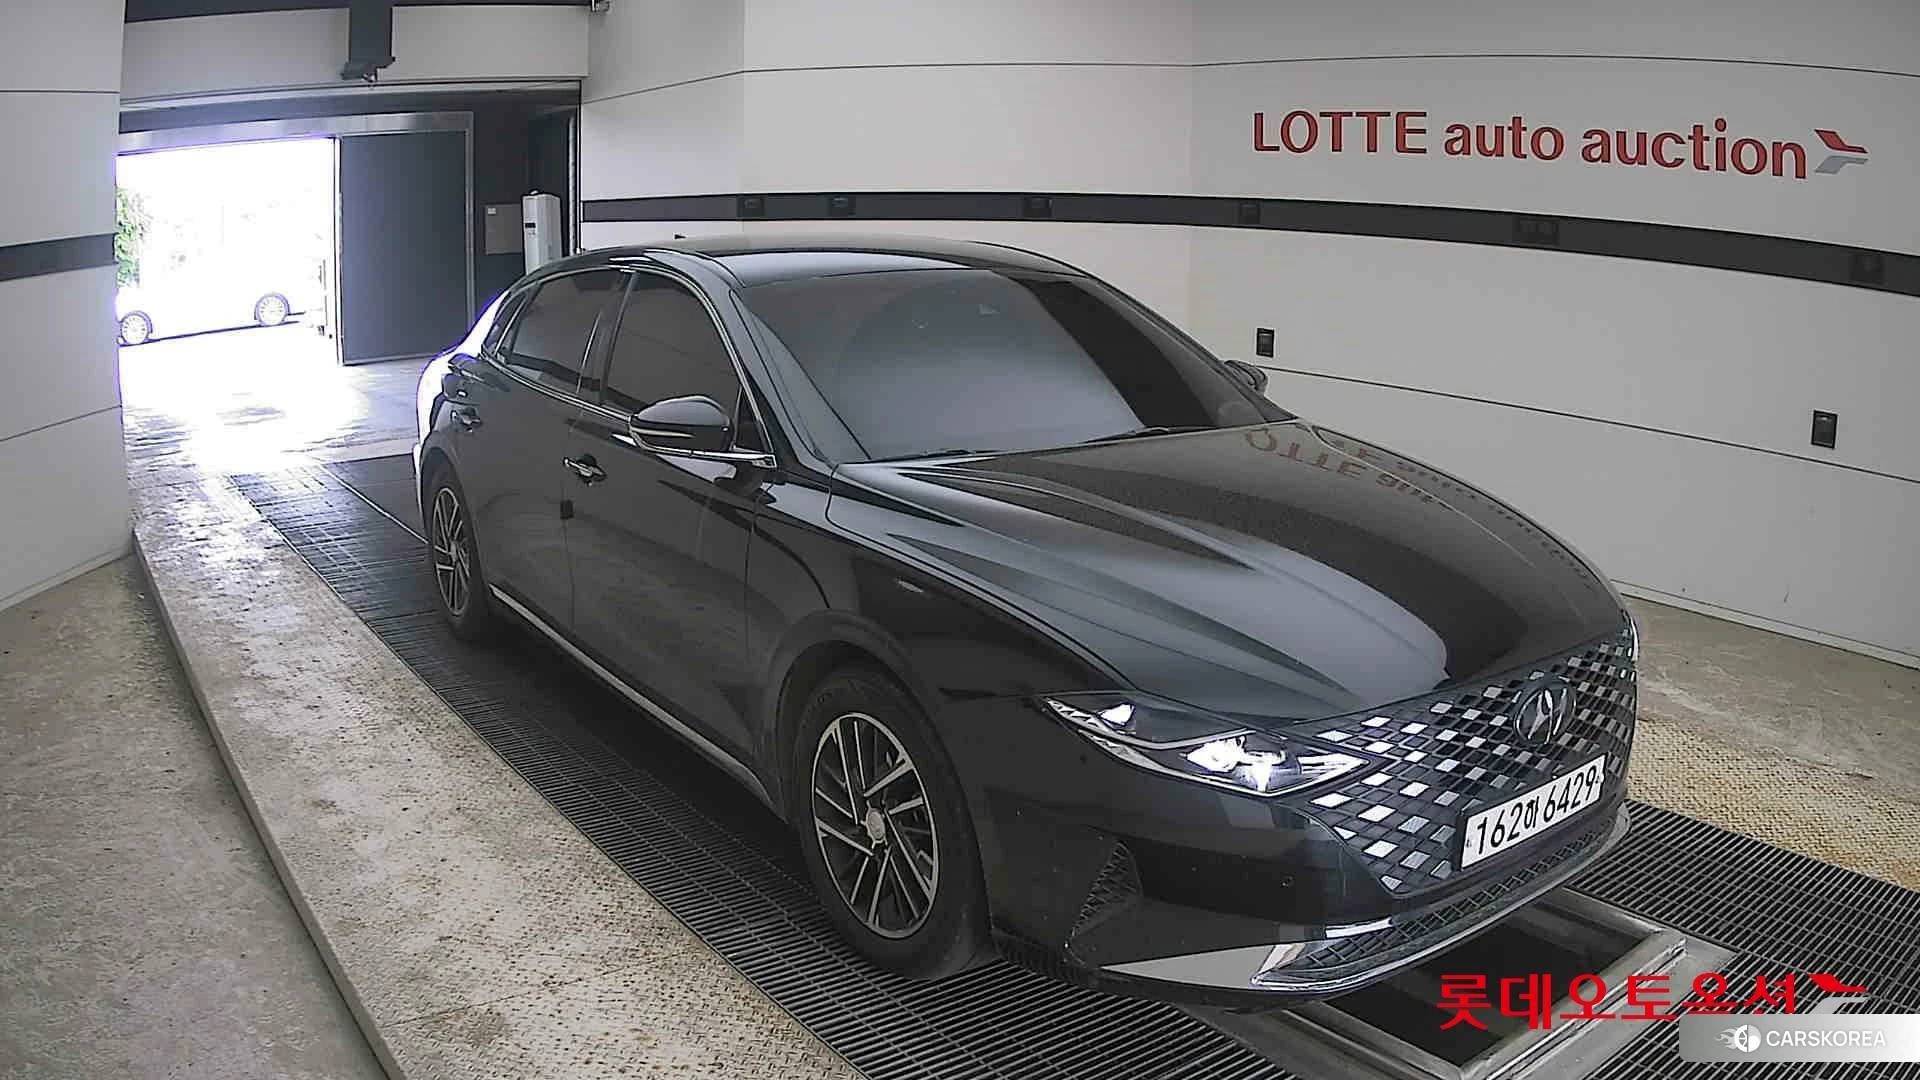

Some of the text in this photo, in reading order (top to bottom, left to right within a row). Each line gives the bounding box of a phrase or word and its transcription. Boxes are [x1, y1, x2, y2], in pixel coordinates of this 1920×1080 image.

[1253, 111, 1807, 179] LOTTE auto auction
[1543, 765, 1597, 822] 6429
